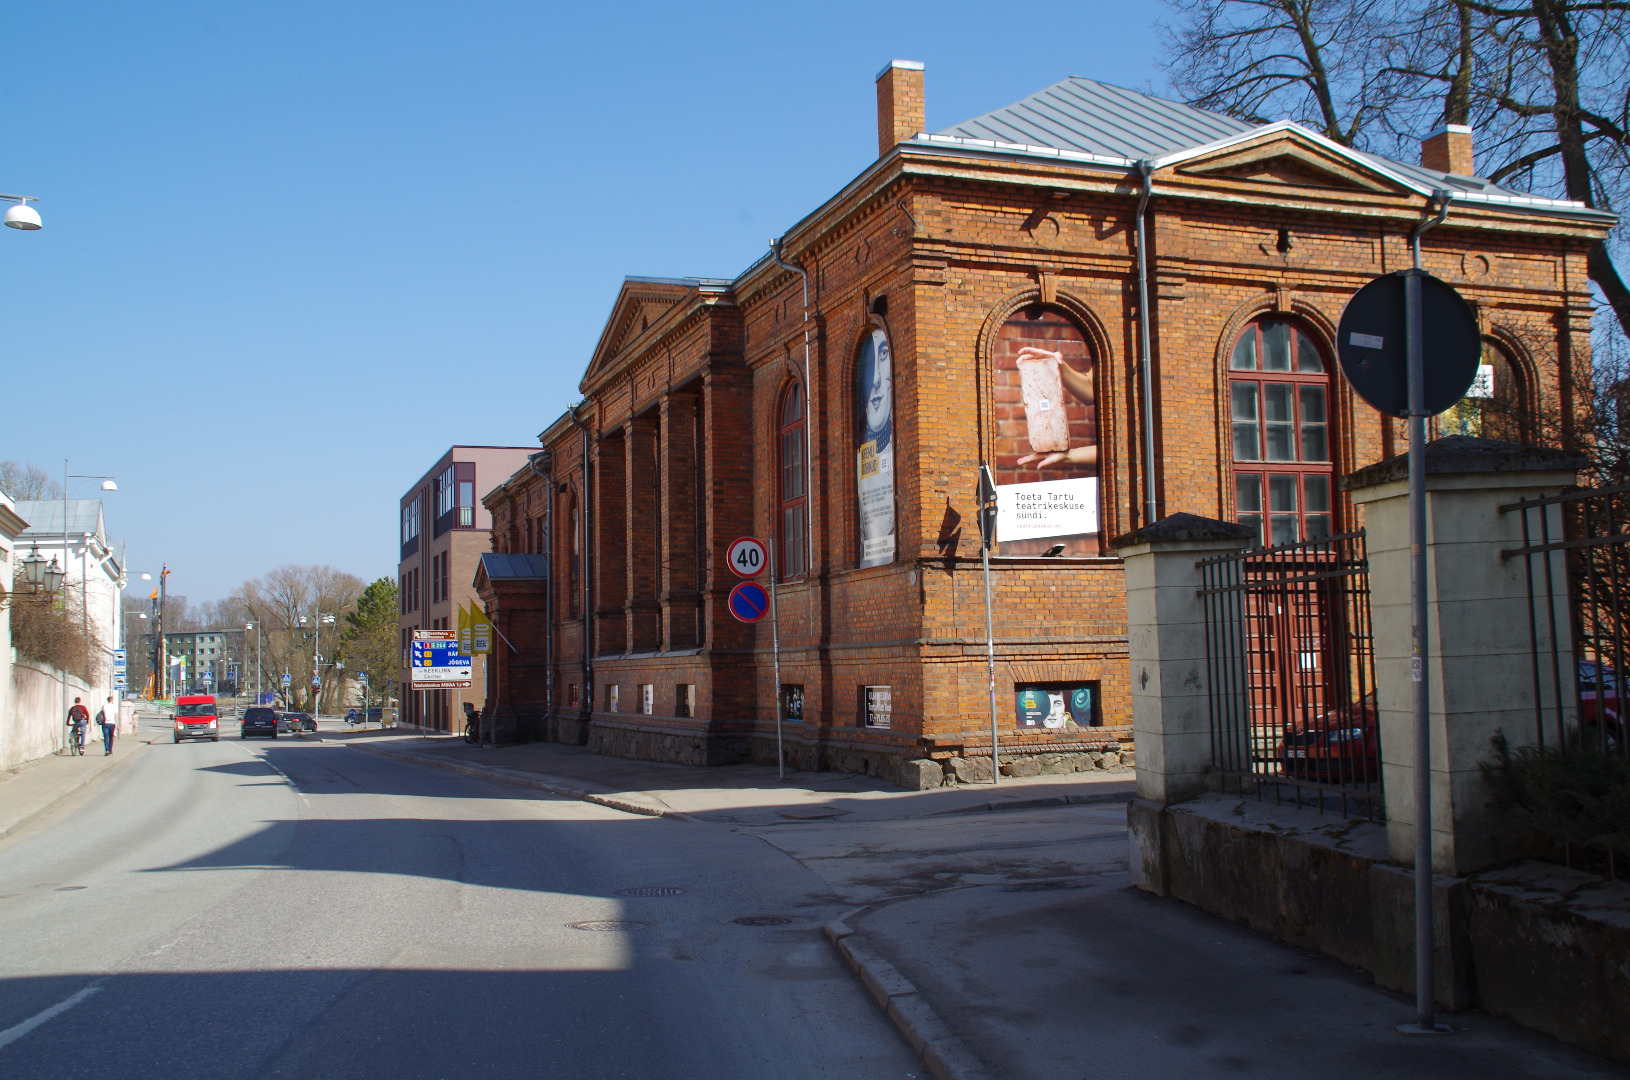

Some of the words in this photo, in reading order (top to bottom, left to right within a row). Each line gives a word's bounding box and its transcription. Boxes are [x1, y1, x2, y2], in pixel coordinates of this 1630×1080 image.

[1015, 492, 1042, 500] Toeta
[1047, 492, 1074, 500] Tartu
[1016, 511, 1047, 519] sündi.
[737, 548, 759, 567] 40
